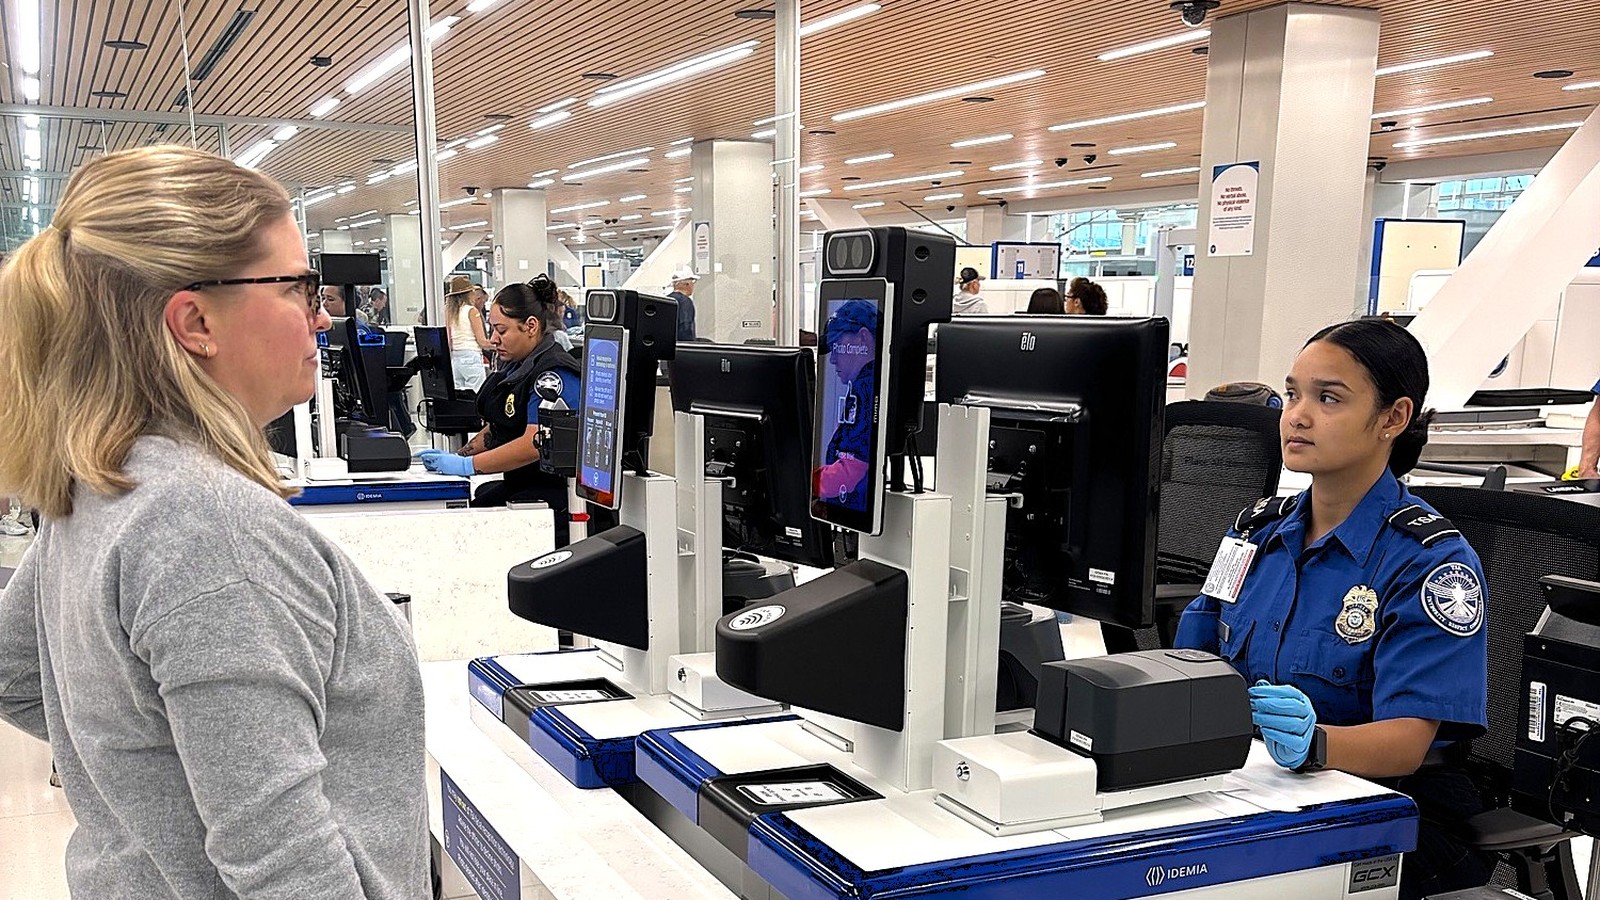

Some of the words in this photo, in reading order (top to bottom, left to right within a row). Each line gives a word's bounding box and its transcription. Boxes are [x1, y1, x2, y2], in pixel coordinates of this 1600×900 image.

[1017, 263, 1024, 273] 11
[1186, 257, 1194, 268] 12
[832, 342, 846, 354] Photo
[846, 343, 868, 355] Complete
[1407, 513, 1445, 526] TSA
[1167, 863, 1208, 880] IDEMIA
[1353, 865, 1396, 883] GCX
